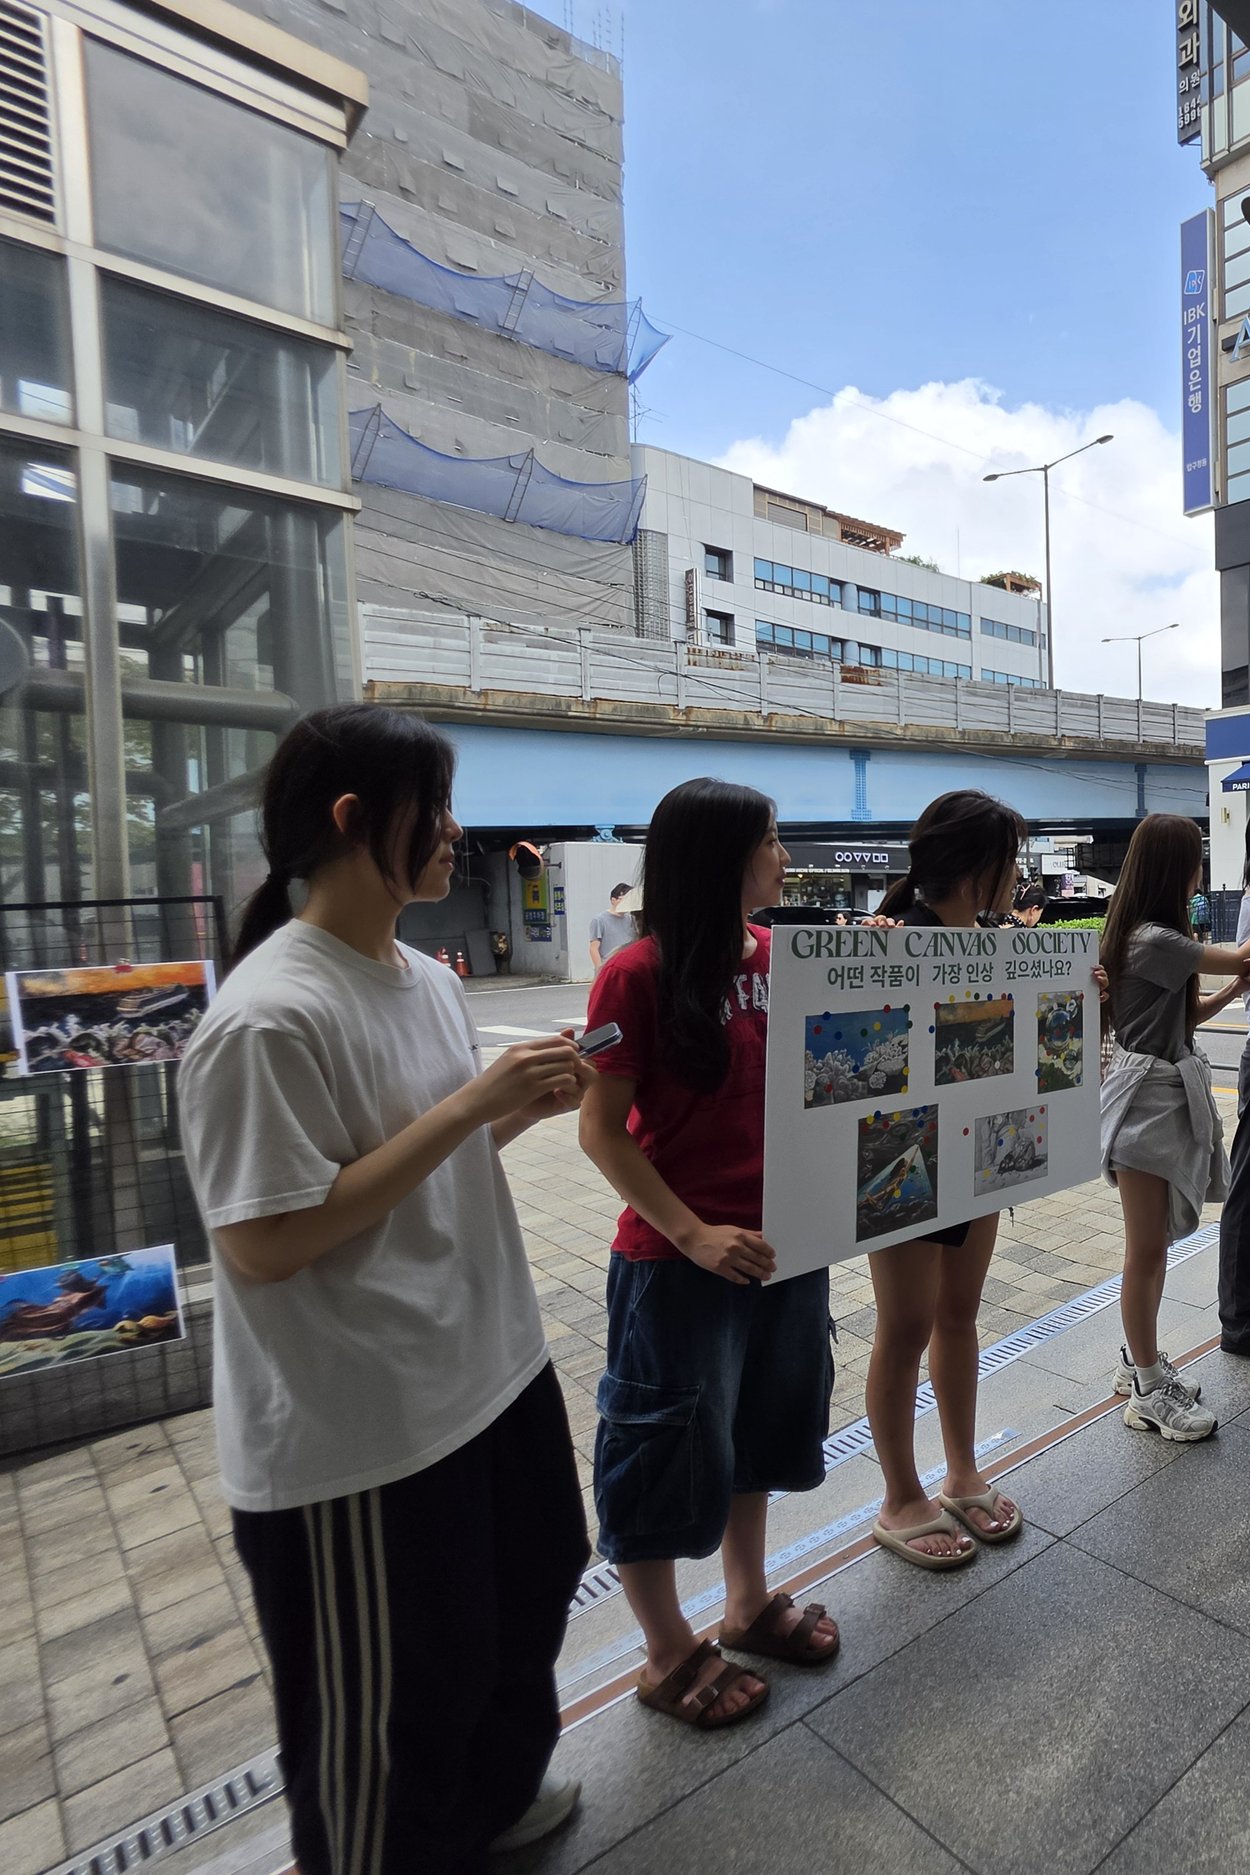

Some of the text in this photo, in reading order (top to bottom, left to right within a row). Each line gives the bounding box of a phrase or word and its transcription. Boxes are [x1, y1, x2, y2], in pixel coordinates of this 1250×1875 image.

[1179, 70, 1200, 93] 의원
[1184, 302, 1206, 326] IBK
[1187, 324, 1202, 414] 기업은행
[791, 929, 1092, 959] GREEN CANVAS SOCIETY
[827, 959, 1072, 990] 어떤 작품이 가장 인상 깊으셨나요?
